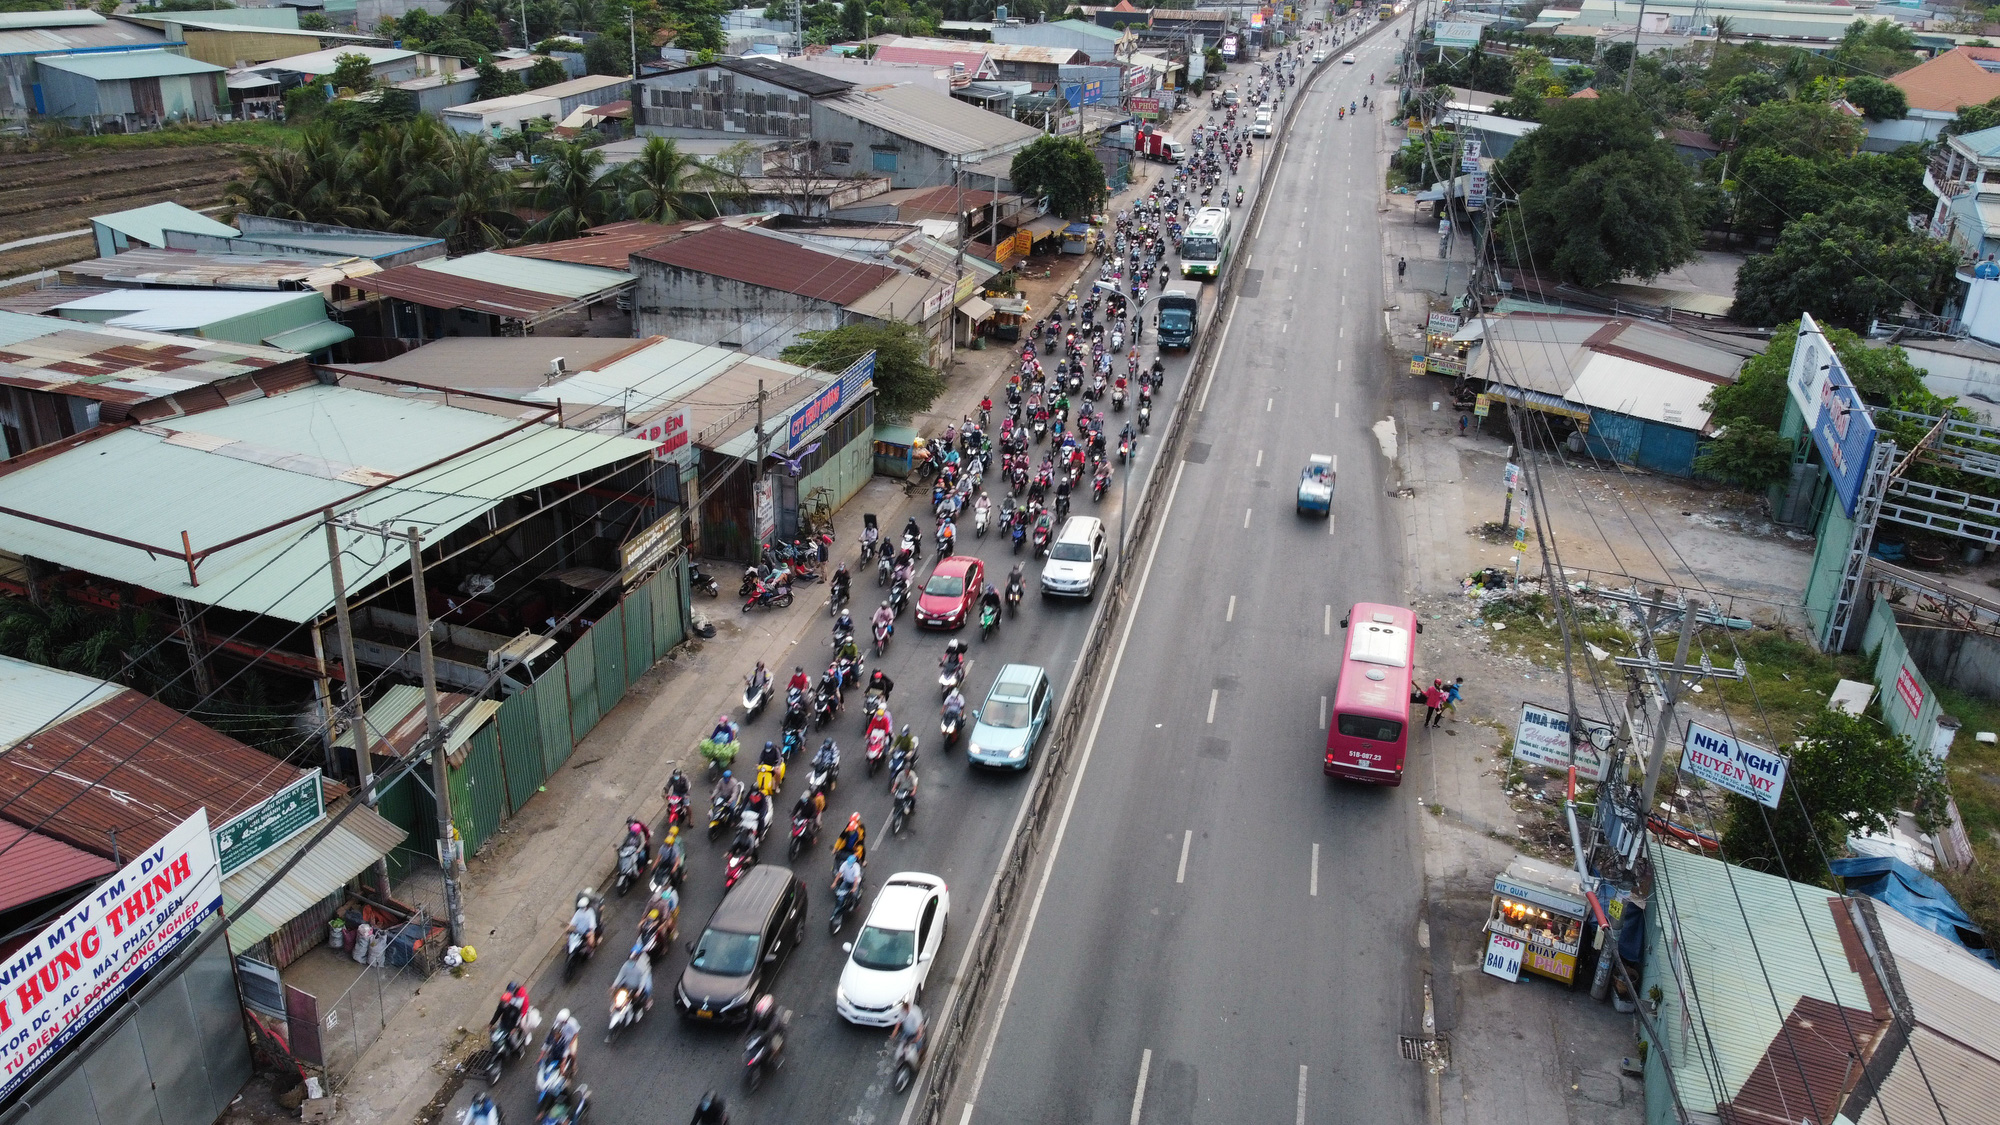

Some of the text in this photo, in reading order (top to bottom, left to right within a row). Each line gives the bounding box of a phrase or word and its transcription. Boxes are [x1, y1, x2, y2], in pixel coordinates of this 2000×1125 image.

[1690, 750, 1775, 792] HUYỀN MY
[1694, 732, 1780, 776] NHÀ NGHỈ
[48, 905, 90, 950] MTV
[96, 879, 126, 908] TM
[141, 847, 164, 875] DV
[1510, 887, 1528, 898] QUAY
[16, 925, 100, 1015] HƯNG
[106, 852, 191, 938] THỊNH
[1494, 935, 1520, 950] 250
[1528, 944, 1558, 958] QUAY
[1532, 934, 1552, 946] HEO
[1553, 942, 1578, 954] QUAY
[32, 1009, 52, 1032] DC
[63, 985, 80, 1006] AC
[92, 949, 119, 979] MÁY
[122, 920, 153, 954] PHÁT
[156, 896, 183, 926] ĐIỆN
[1487, 953, 1504, 969] BAO
[4, 901, 199, 1074] TỦ ĐIỆN TỰ ĐỘNG CÔNG NGHIỆP
[59, 1032, 74, 1045] TP.
[74, 1014, 88, 1032] HỒ
[88, 998, 104, 1018] CHÍ
[104, 982, 126, 1006] MINH
